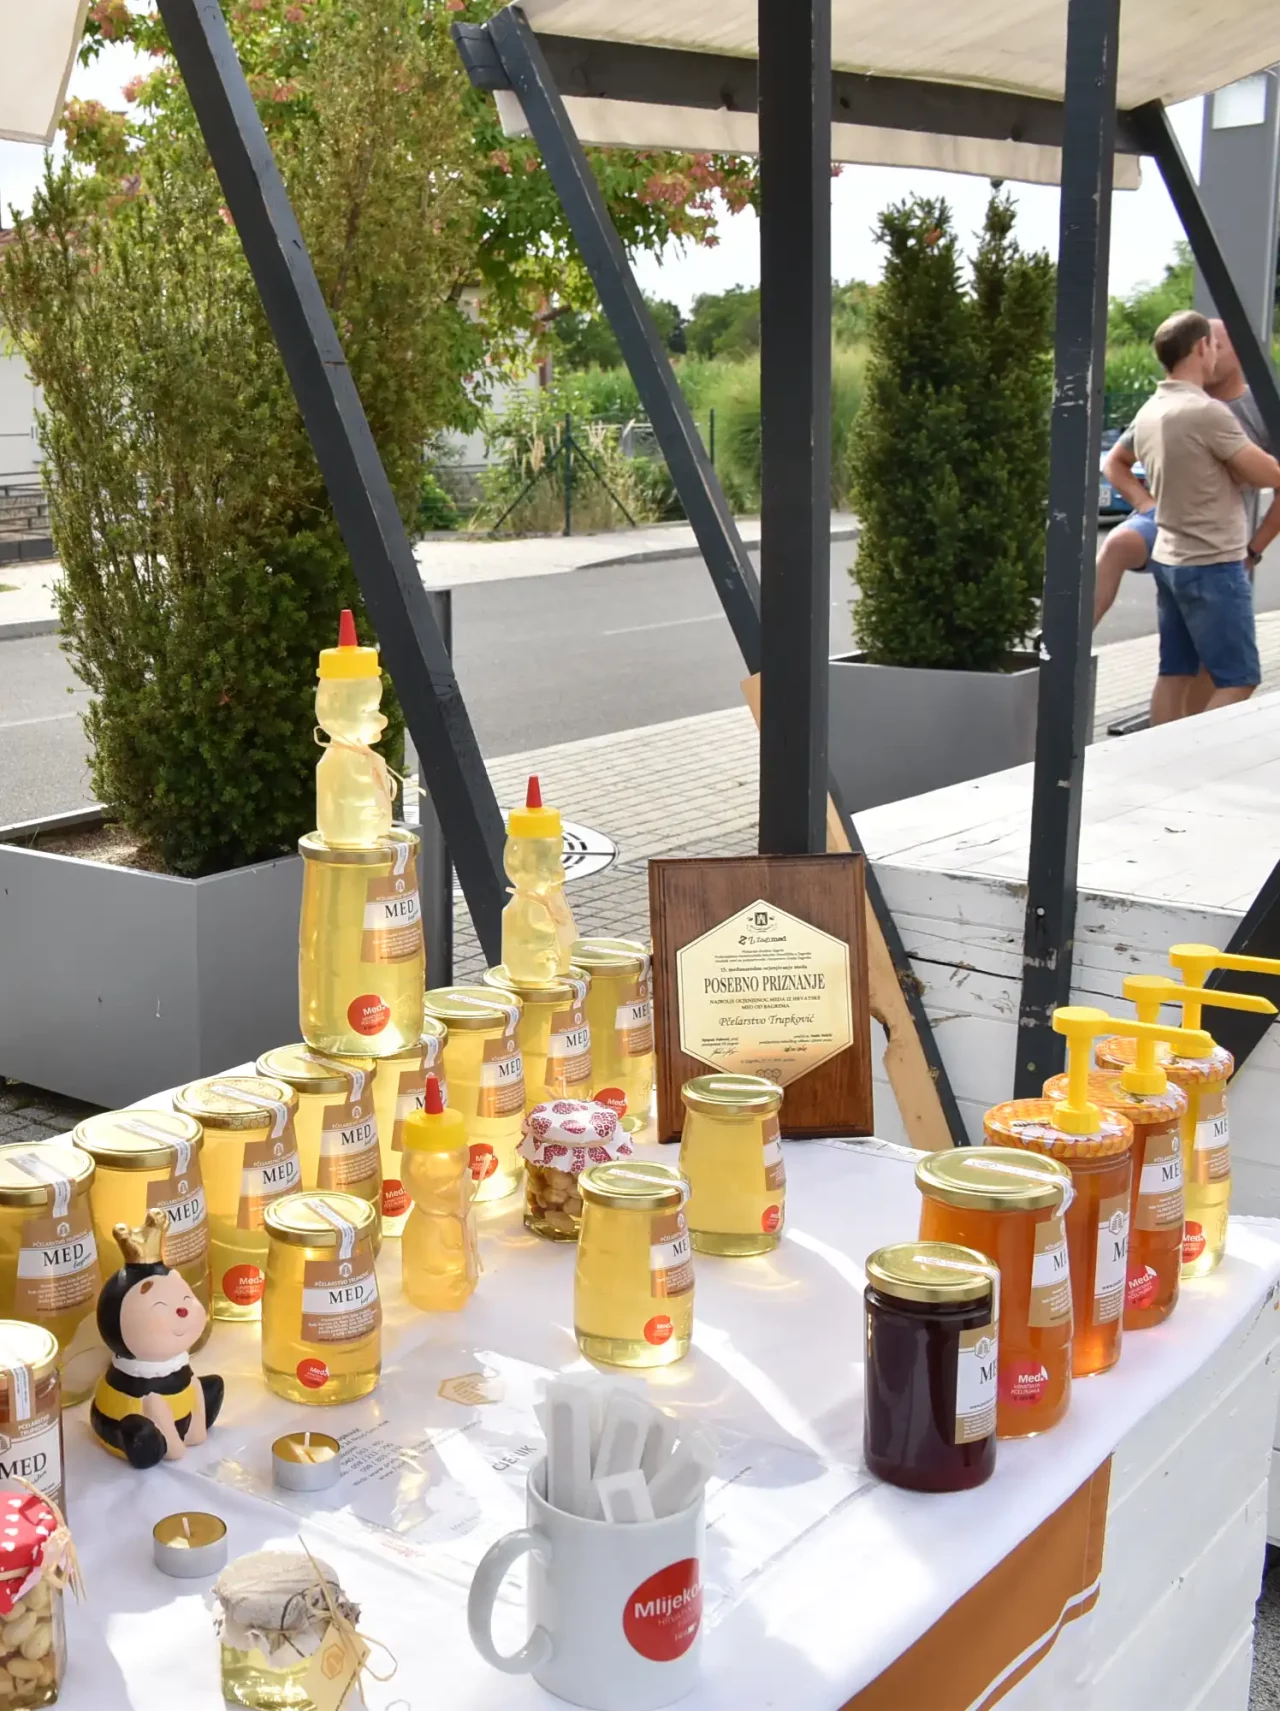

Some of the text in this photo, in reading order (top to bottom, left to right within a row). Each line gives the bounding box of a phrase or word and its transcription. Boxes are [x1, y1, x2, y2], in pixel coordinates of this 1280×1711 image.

[385, 899, 414, 919] MED
[704, 973, 826, 994] POSEBNO PRIZNANJE
[719, 1013, 815, 1027] Pčelarstvo Trupković
[565, 1029, 588, 1048] MED
[498, 1057, 521, 1078] MED
[341, 1124, 371, 1146] MED
[262, 1161, 294, 1185] MED
[1161, 1162, 1179, 1182] ME
[167, 1198, 199, 1223] MED
[43, 1243, 84, 1267] MED
[329, 1285, 364, 1304] MED
